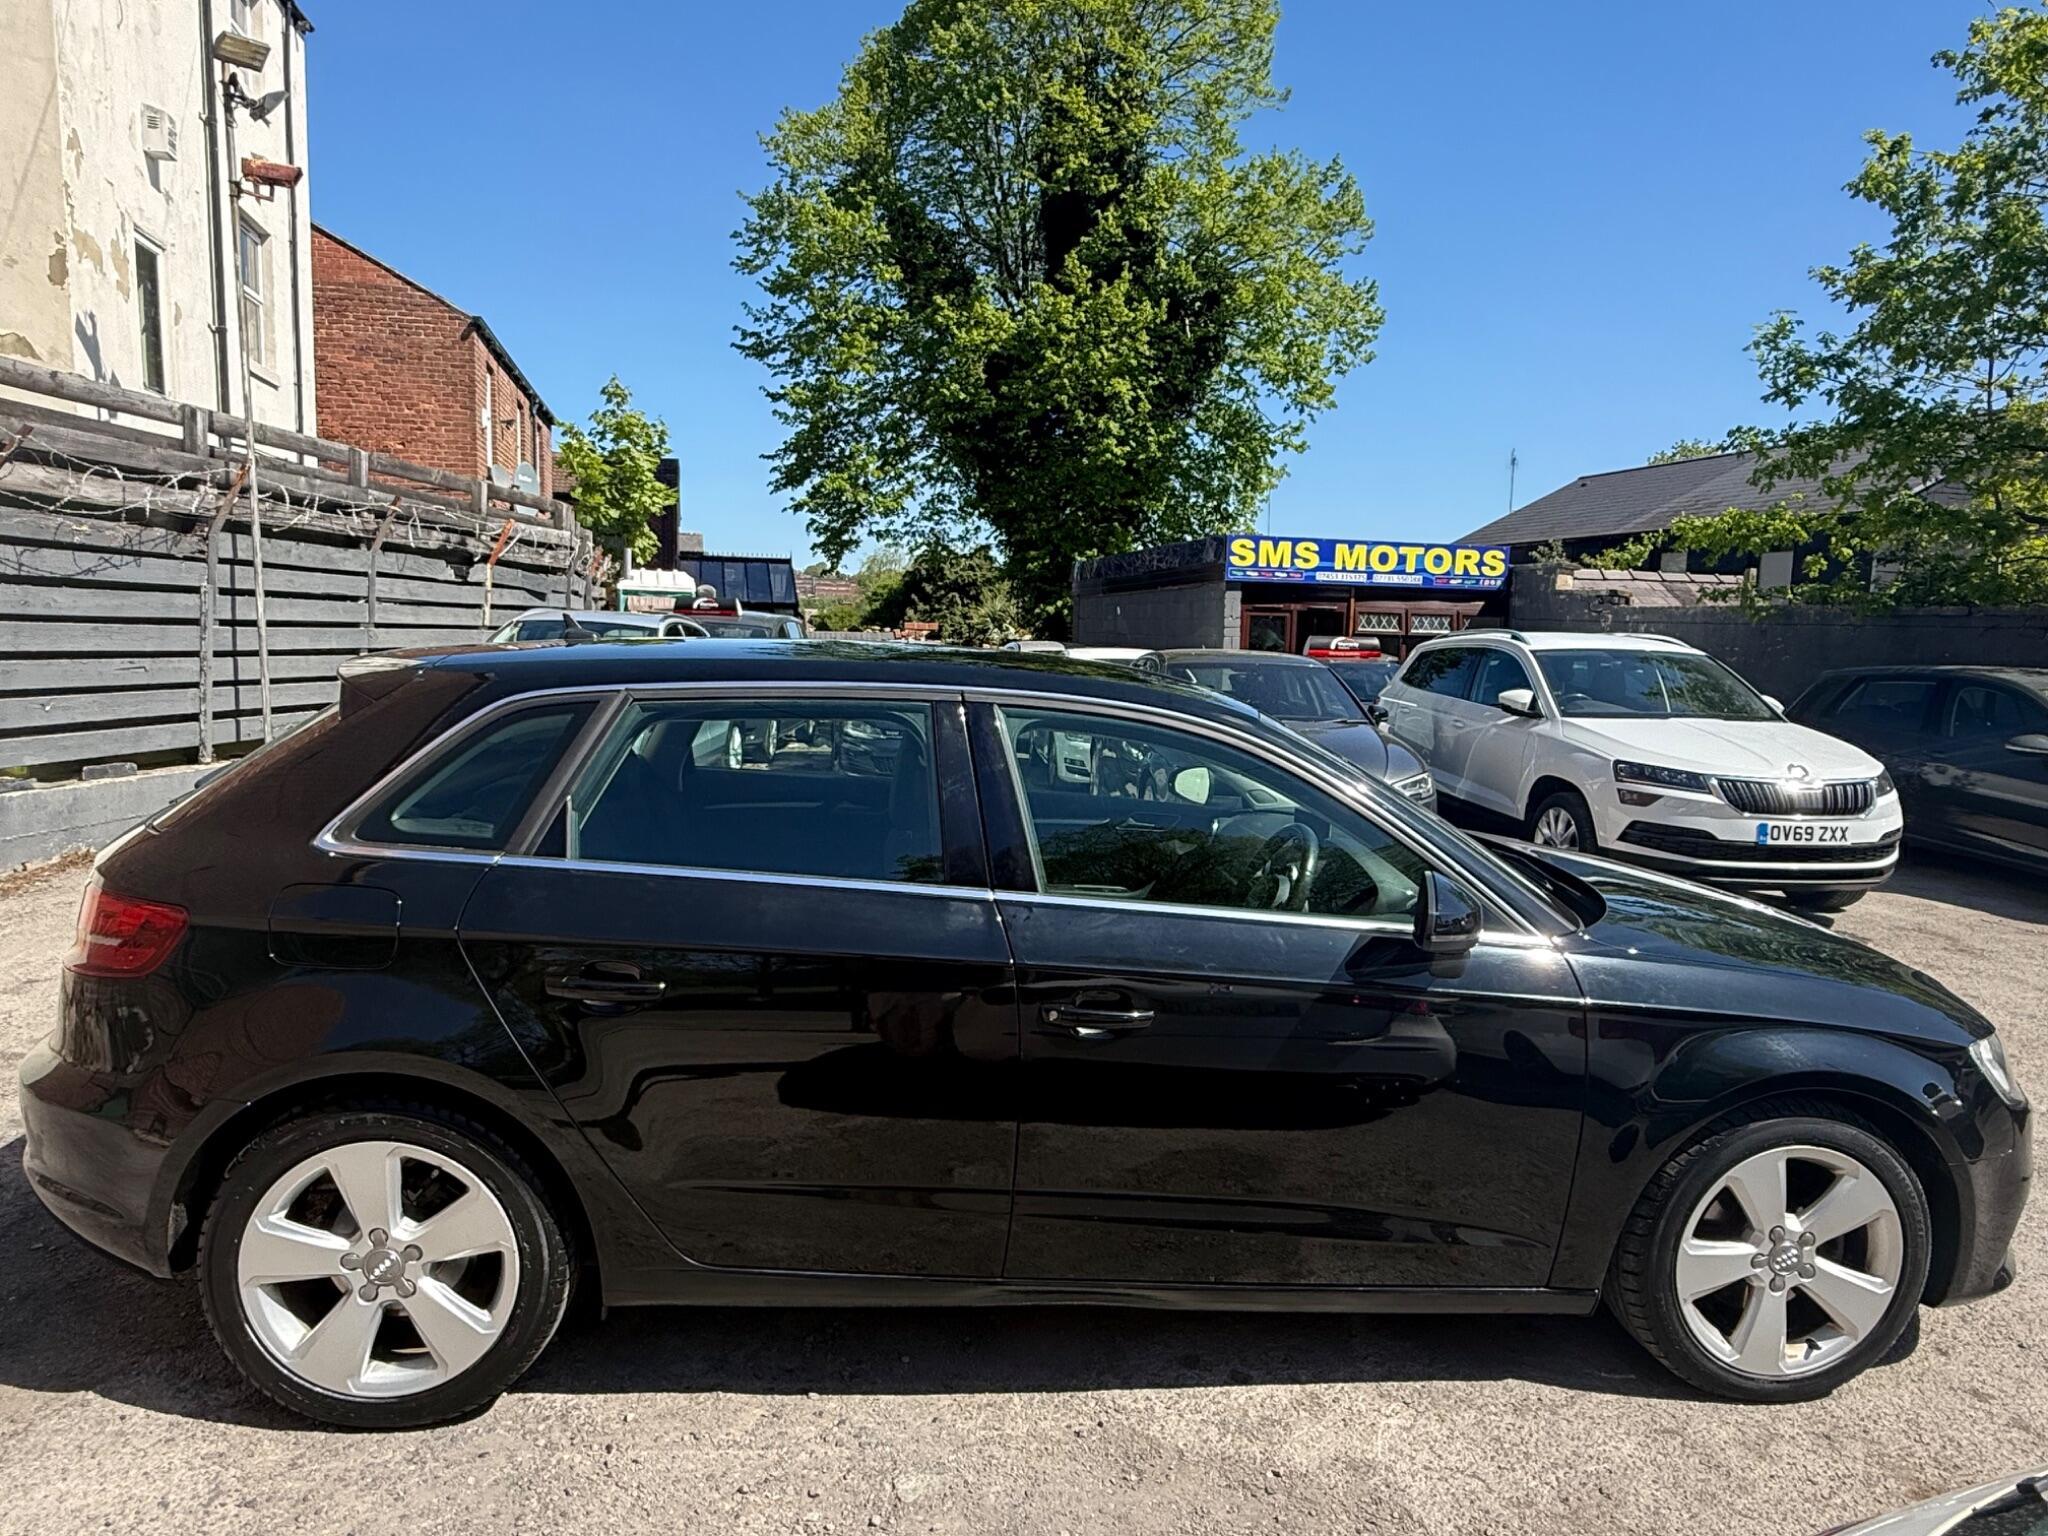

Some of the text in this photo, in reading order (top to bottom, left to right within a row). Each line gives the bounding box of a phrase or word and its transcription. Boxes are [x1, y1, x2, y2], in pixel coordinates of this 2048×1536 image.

[1229, 539, 1506, 577] SMS MOTORS
[1770, 825, 1814, 841] OV69
[1818, 826, 1849, 842] ZXX
